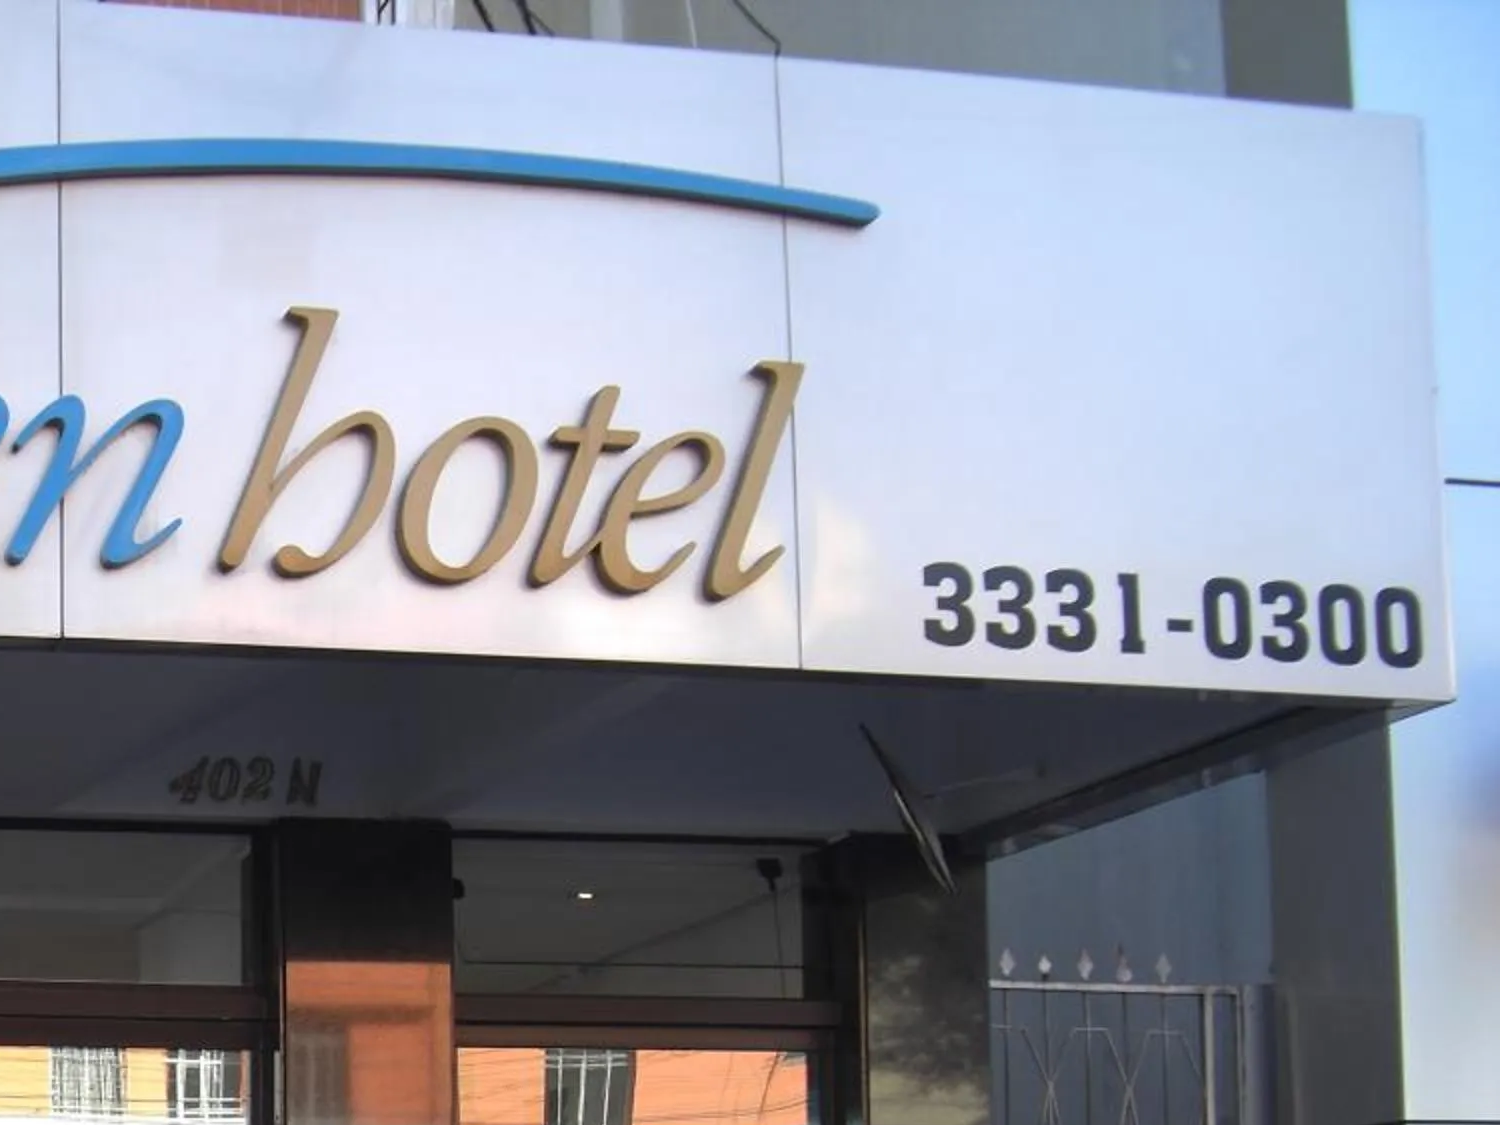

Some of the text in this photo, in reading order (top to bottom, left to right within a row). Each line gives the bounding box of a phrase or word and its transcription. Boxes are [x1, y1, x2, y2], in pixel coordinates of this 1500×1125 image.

[217, 305, 805, 602] hotel
[923, 561, 1423, 669] 3331-0300
[168, 755, 323, 806] 402 N
